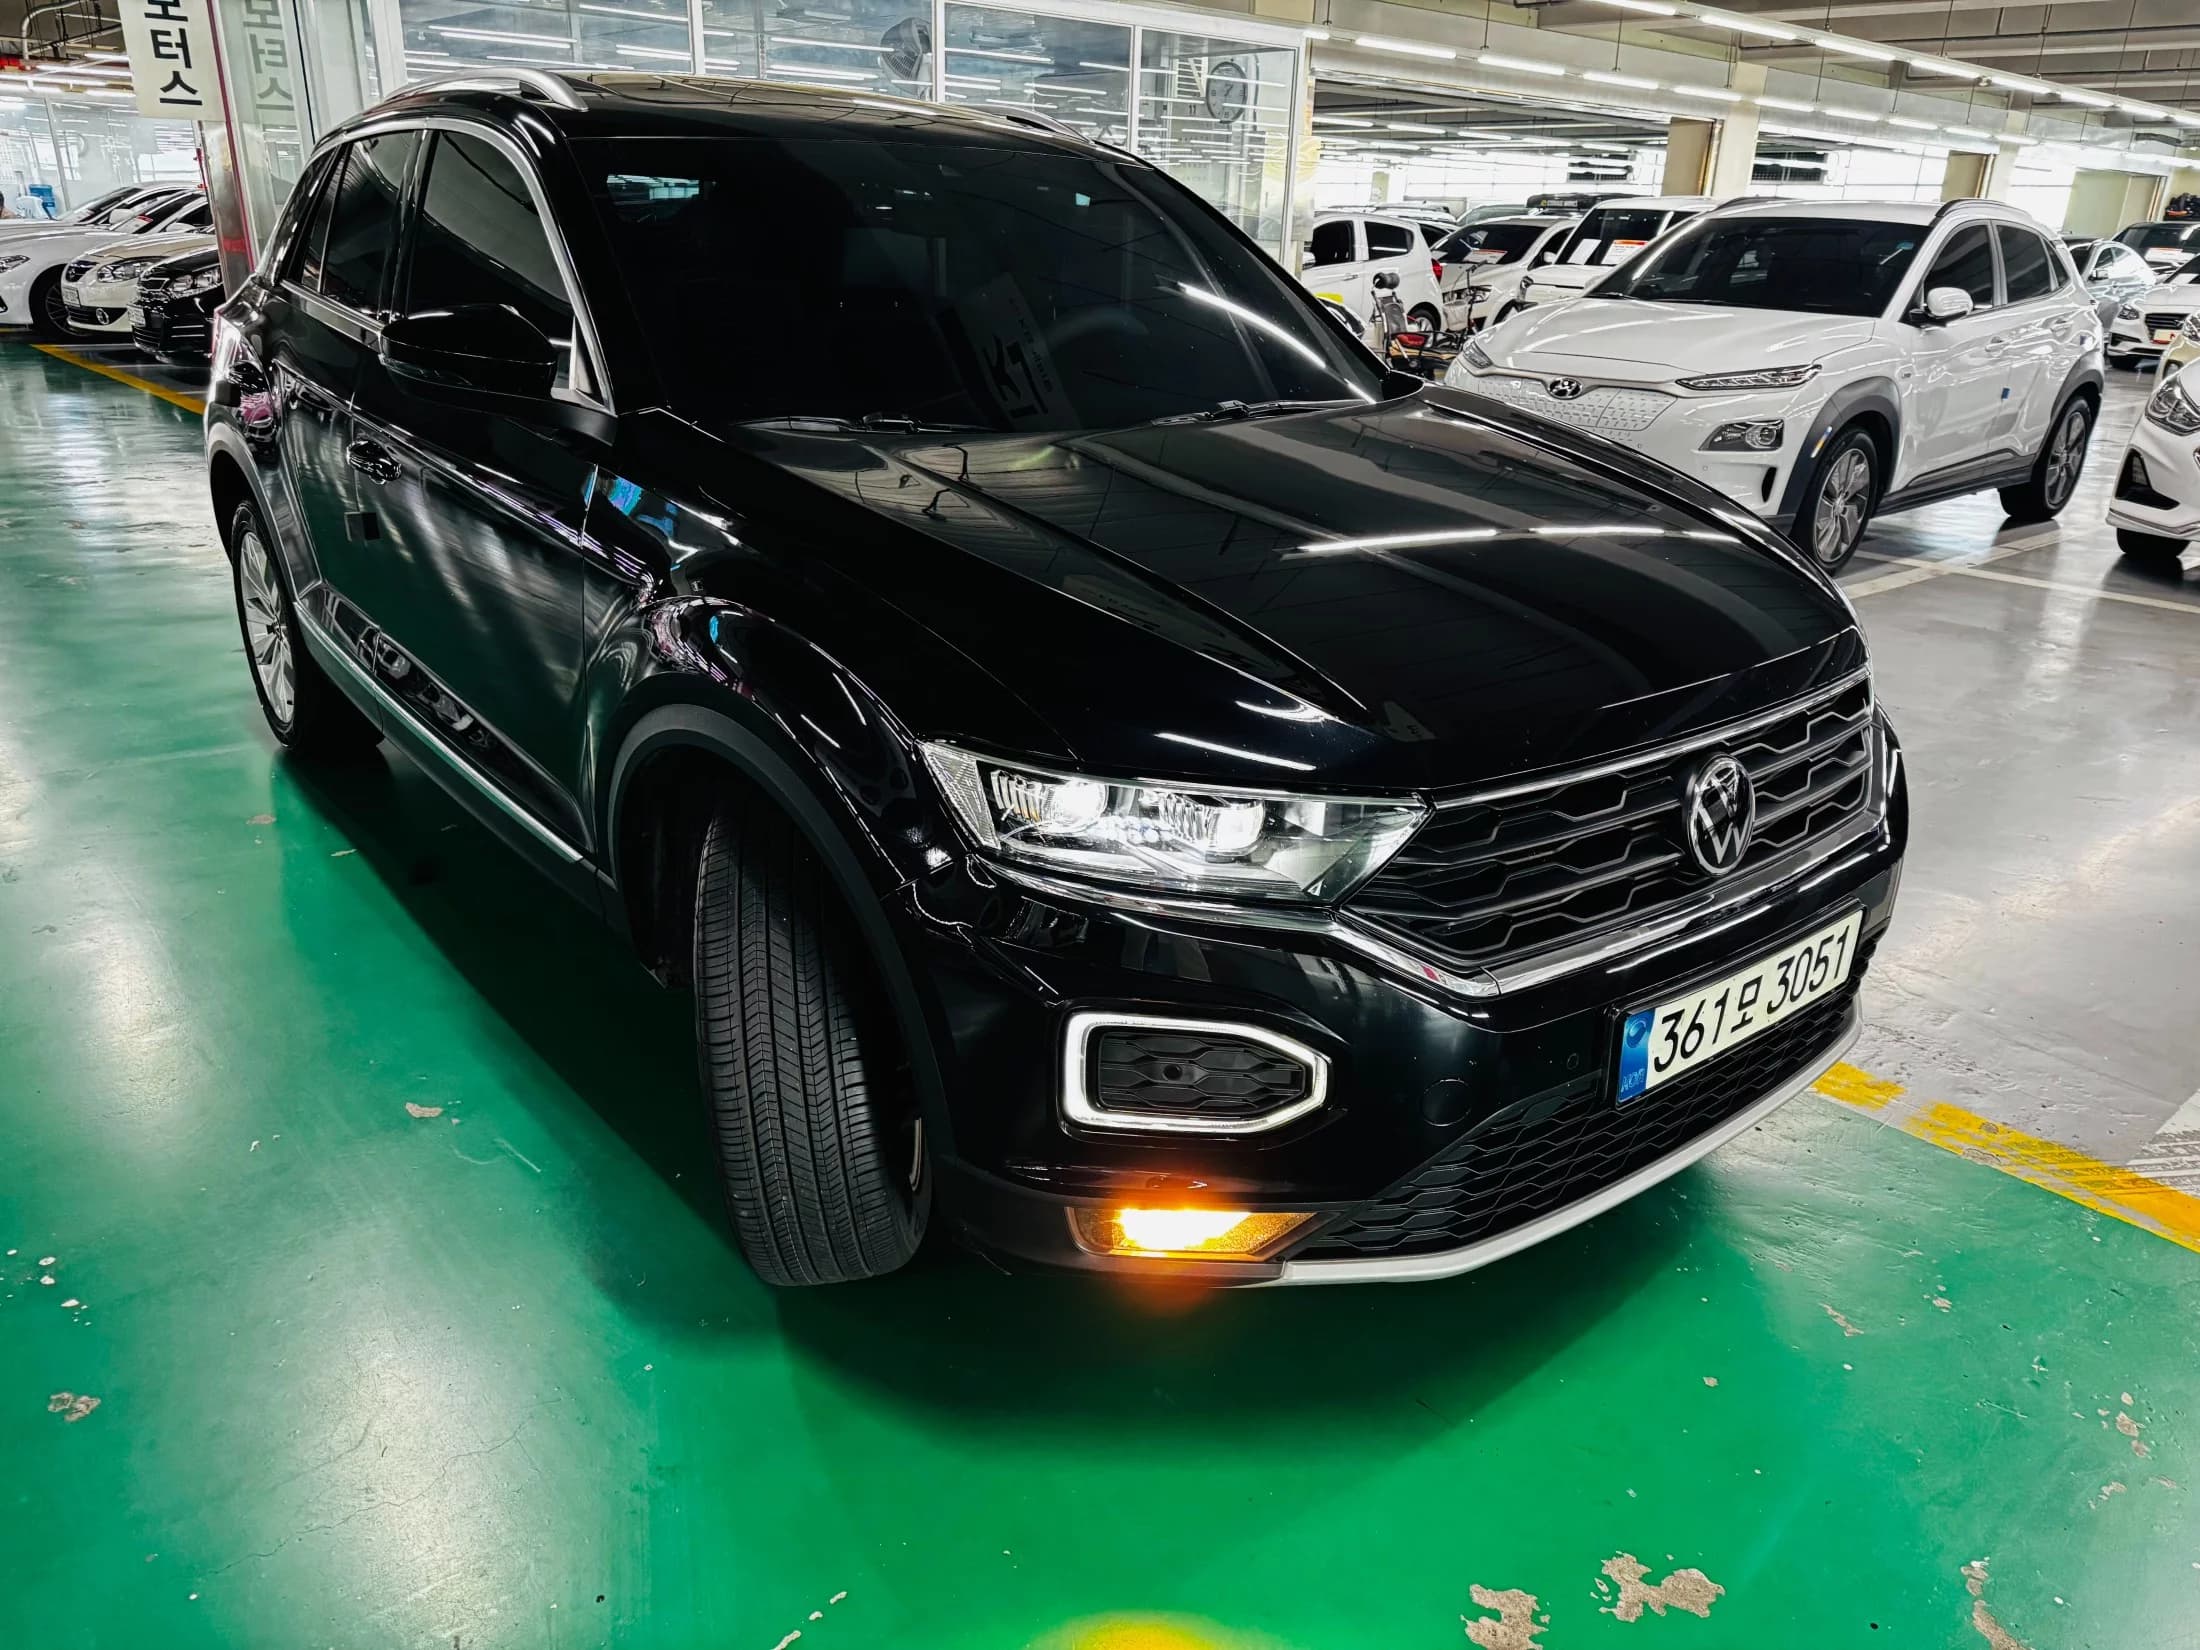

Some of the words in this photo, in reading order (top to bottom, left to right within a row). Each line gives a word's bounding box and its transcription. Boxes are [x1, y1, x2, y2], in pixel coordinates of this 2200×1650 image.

[144, 0, 203, 106] 모터스
[1653, 974, 1763, 1073] 361모
[1766, 924, 1850, 1015] 3051
